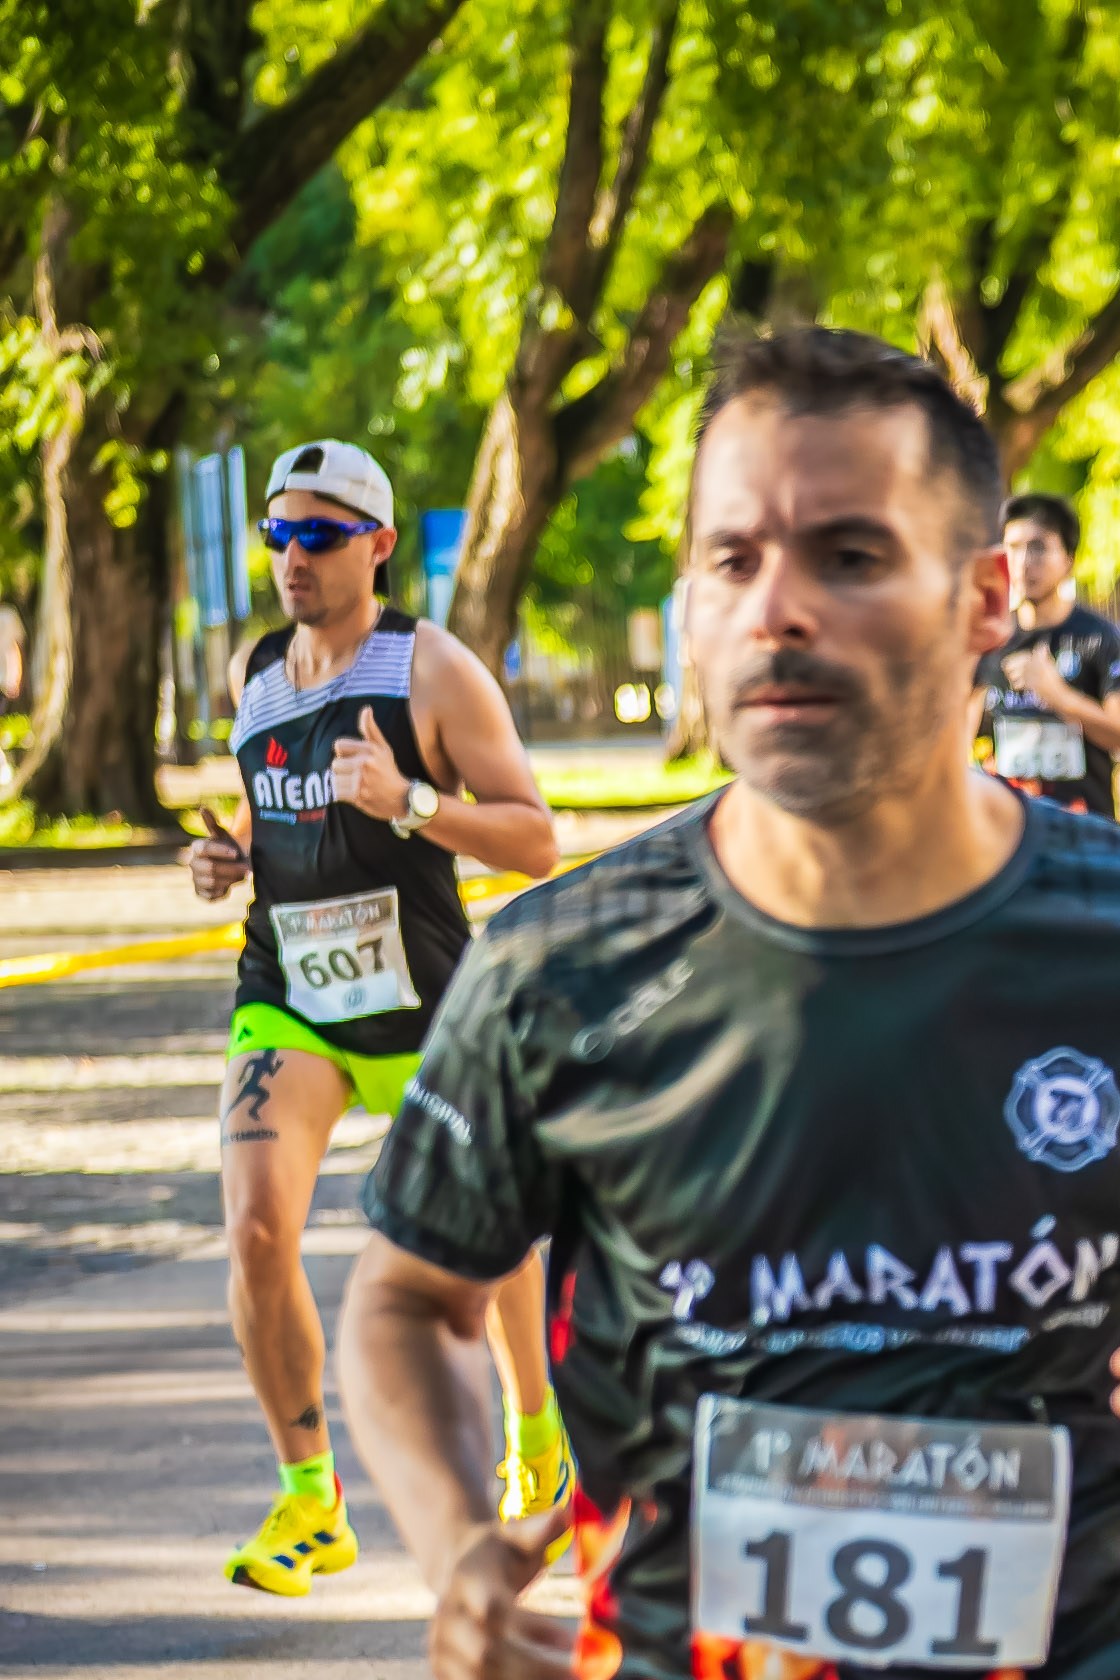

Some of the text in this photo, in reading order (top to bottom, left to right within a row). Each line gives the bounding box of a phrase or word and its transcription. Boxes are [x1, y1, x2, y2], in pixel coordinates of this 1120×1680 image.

[300, 936, 385, 989] 607
[749, 1214, 1120, 1326] MARATÓN
[801, 1431, 1021, 1492] MARATÓN
[743, 1528, 1001, 1658] 181
